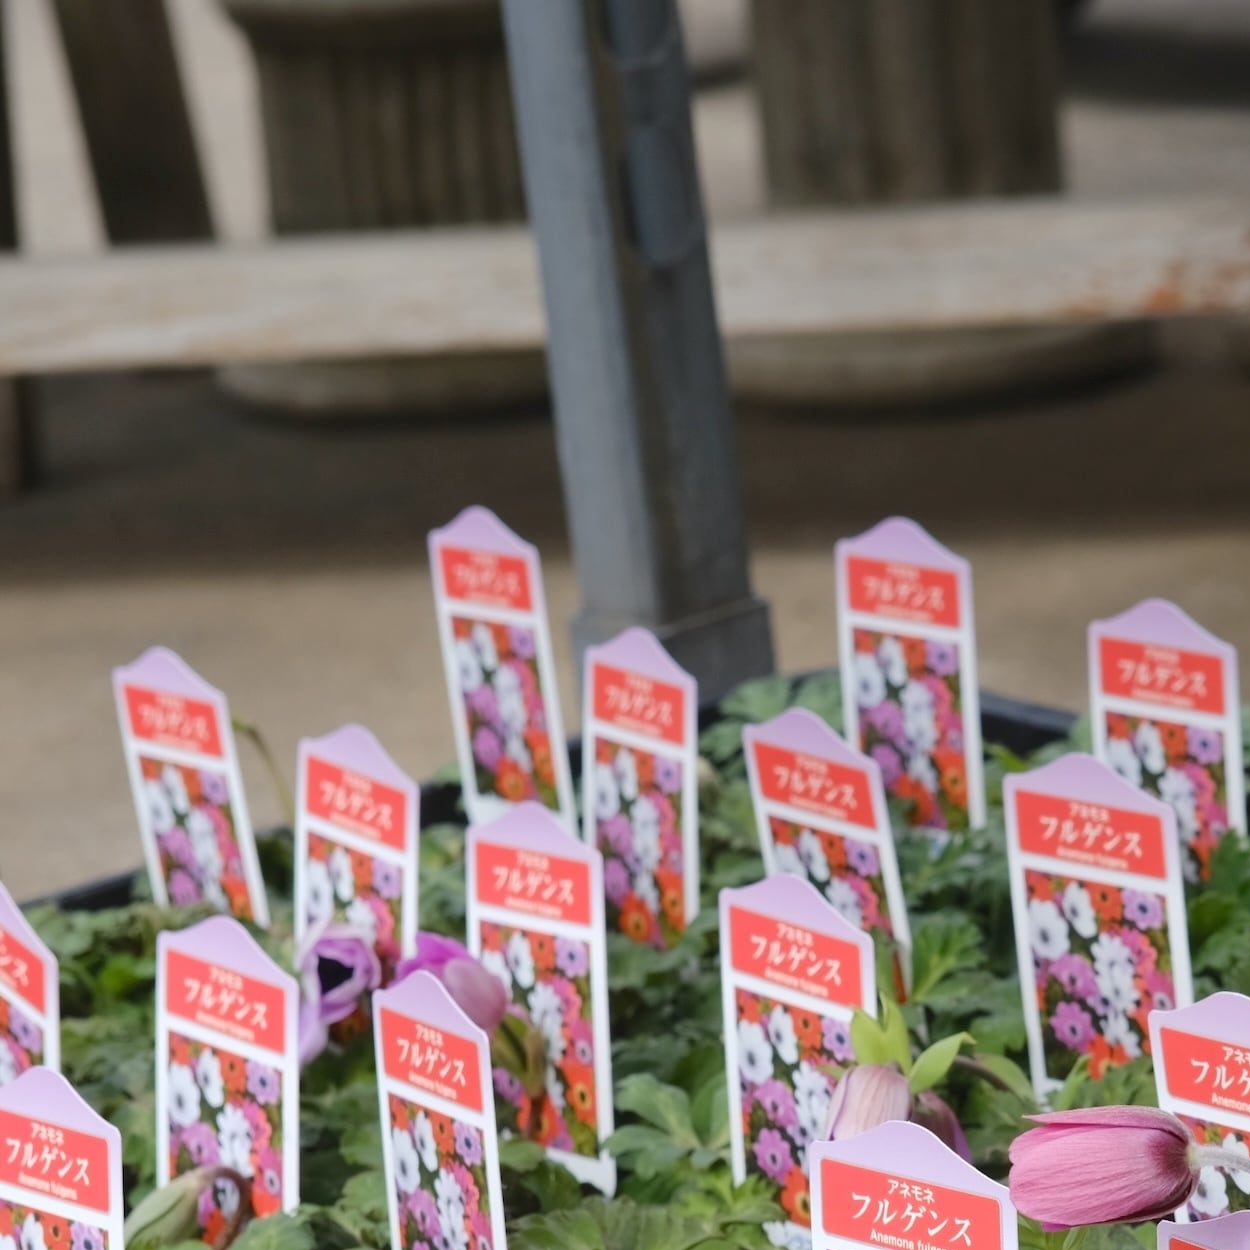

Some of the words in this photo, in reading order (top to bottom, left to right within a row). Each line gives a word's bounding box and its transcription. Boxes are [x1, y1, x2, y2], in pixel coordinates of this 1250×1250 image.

[1040, 815, 1141, 857] フルゲンス
[493, 866, 574, 904] フルゲンス
[750, 934, 842, 985] フルゲンス
[184, 977, 267, 1029] フルゲンス
[397, 1037, 466, 1086] フルゲンス
[6, 1137, 90, 1186] フルゲンス
[887, 1178, 935, 1204] アネモネ
[851, 1192, 972, 1247] フルゲンス
[869, 1228, 915, 1250] Anemone
